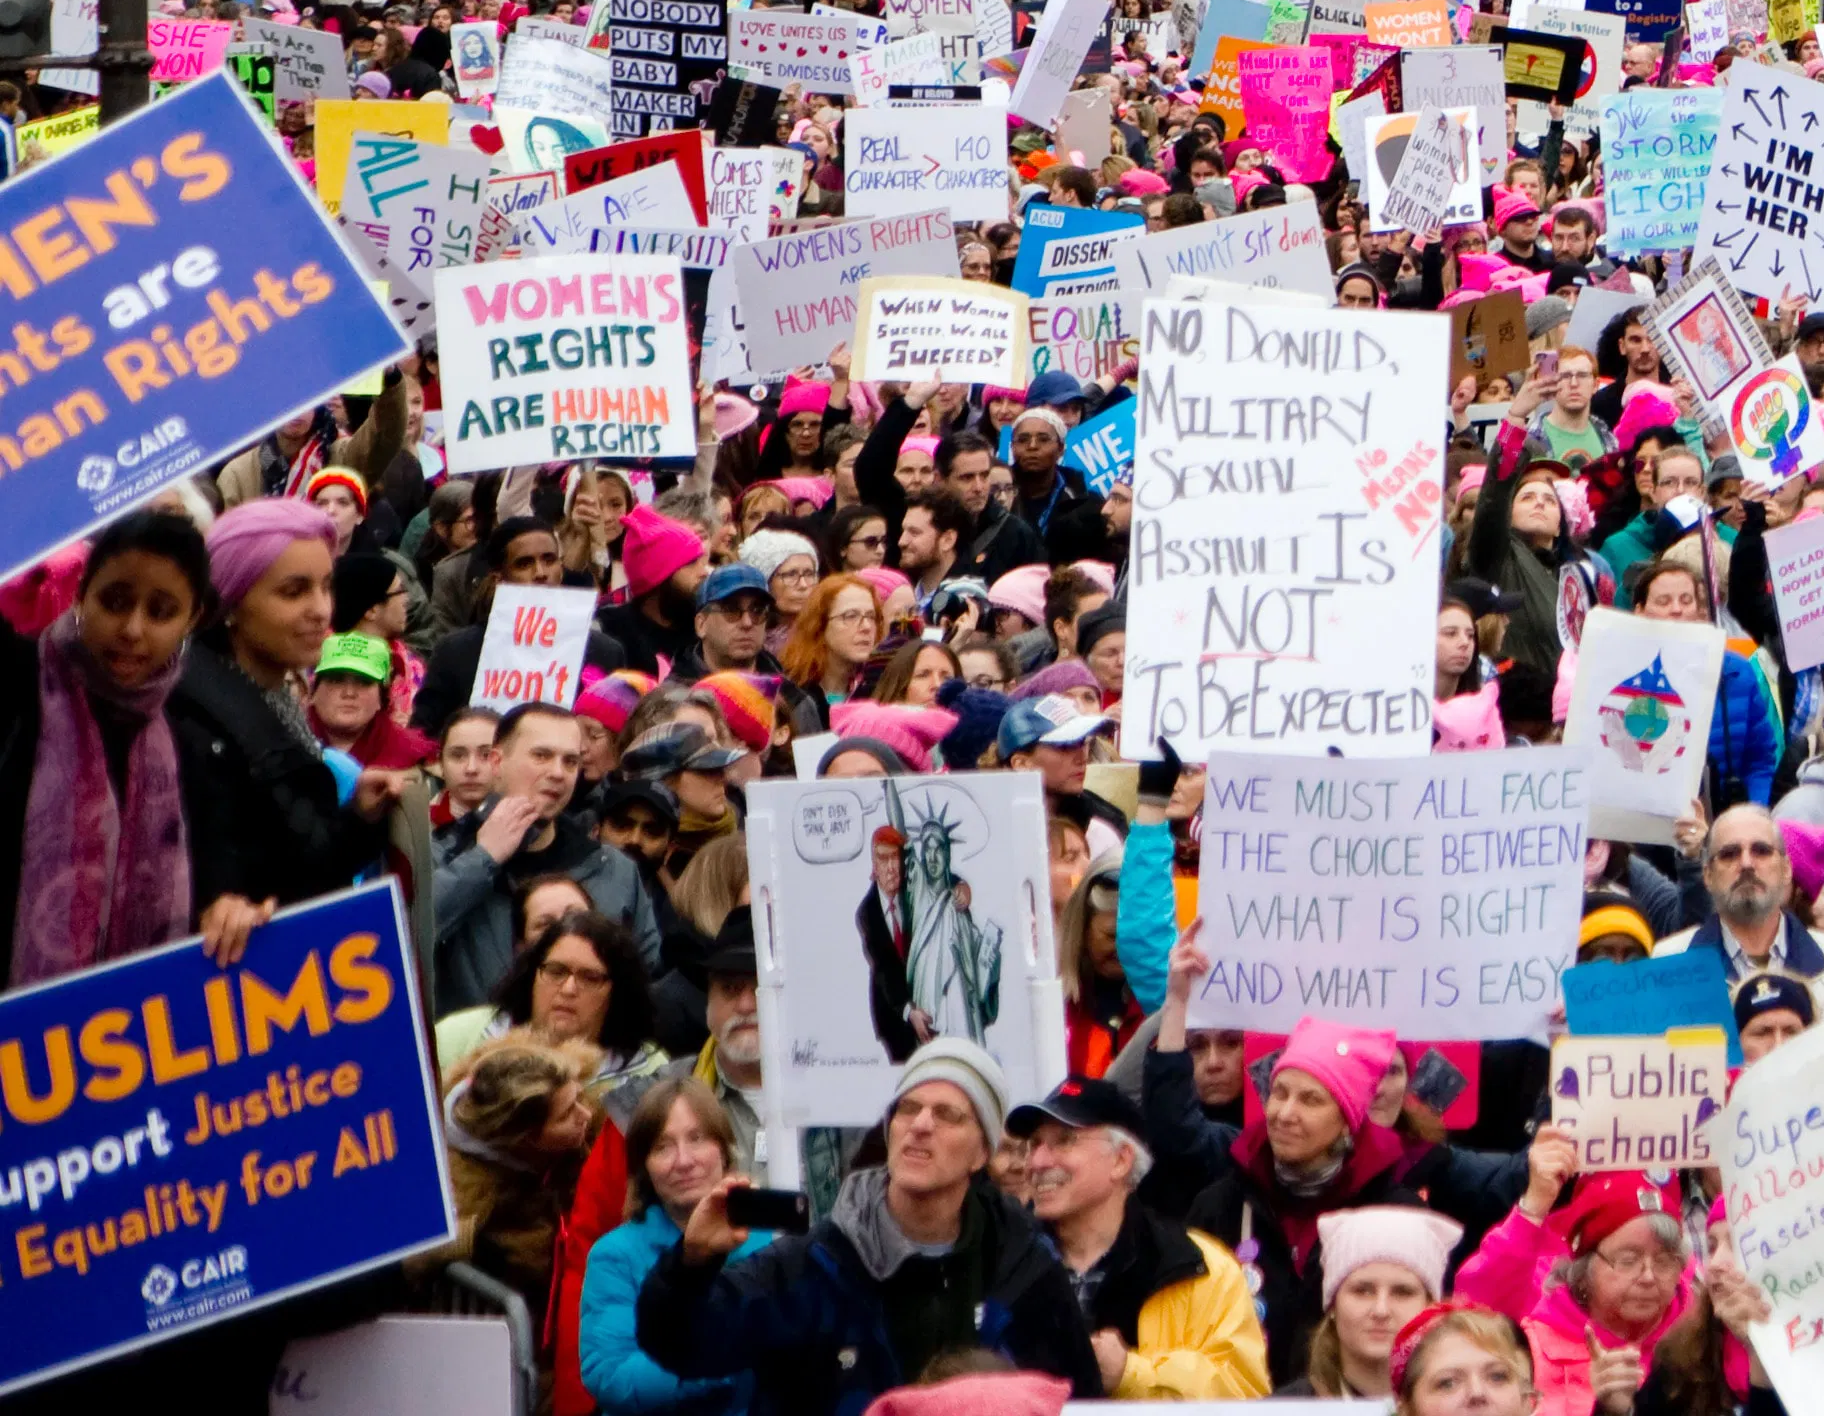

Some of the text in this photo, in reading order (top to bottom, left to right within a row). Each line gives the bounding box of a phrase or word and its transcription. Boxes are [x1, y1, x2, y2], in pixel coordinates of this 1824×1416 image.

[611, 29, 723, 59] PUTS MY
[611, 60, 676, 83] BABY
[1768, 139, 1814, 172] I'M
[1745, 164, 1824, 211] WITH
[753, 212, 952, 271] WOMEN'S RIGHTS
[1747, 203, 1808, 240] HER
[103, 245, 221, 329] are
[840, 262, 872, 284] ARE
[464, 274, 681, 326] WOMEN'S
[777, 297, 858, 335] HUMAN
[105, 263, 334, 402] Rights
[490, 326, 656, 379] RIGHTS
[976, 323, 1009, 339] ALL
[458, 387, 669, 441] ARE HUMAN
[551, 423, 662, 456] RIGHTS
[512, 608, 557, 648] We
[1203, 586, 1334, 656] NOT
[483, 665, 568, 703] won't
[1210, 770, 1582, 822] WE MUST ALL FACE
[1220, 825, 1581, 877] THE CHOICE BETWEEN
[1227, 884, 1555, 942] WHAT IS RIGHT
[1201, 954, 1569, 1009] AND WHAT IS EASY
[185, 1061, 362, 1145] Justice
[15, 1109, 396, 1278] Equality for All
[181, 1245, 248, 1288] CAIR
